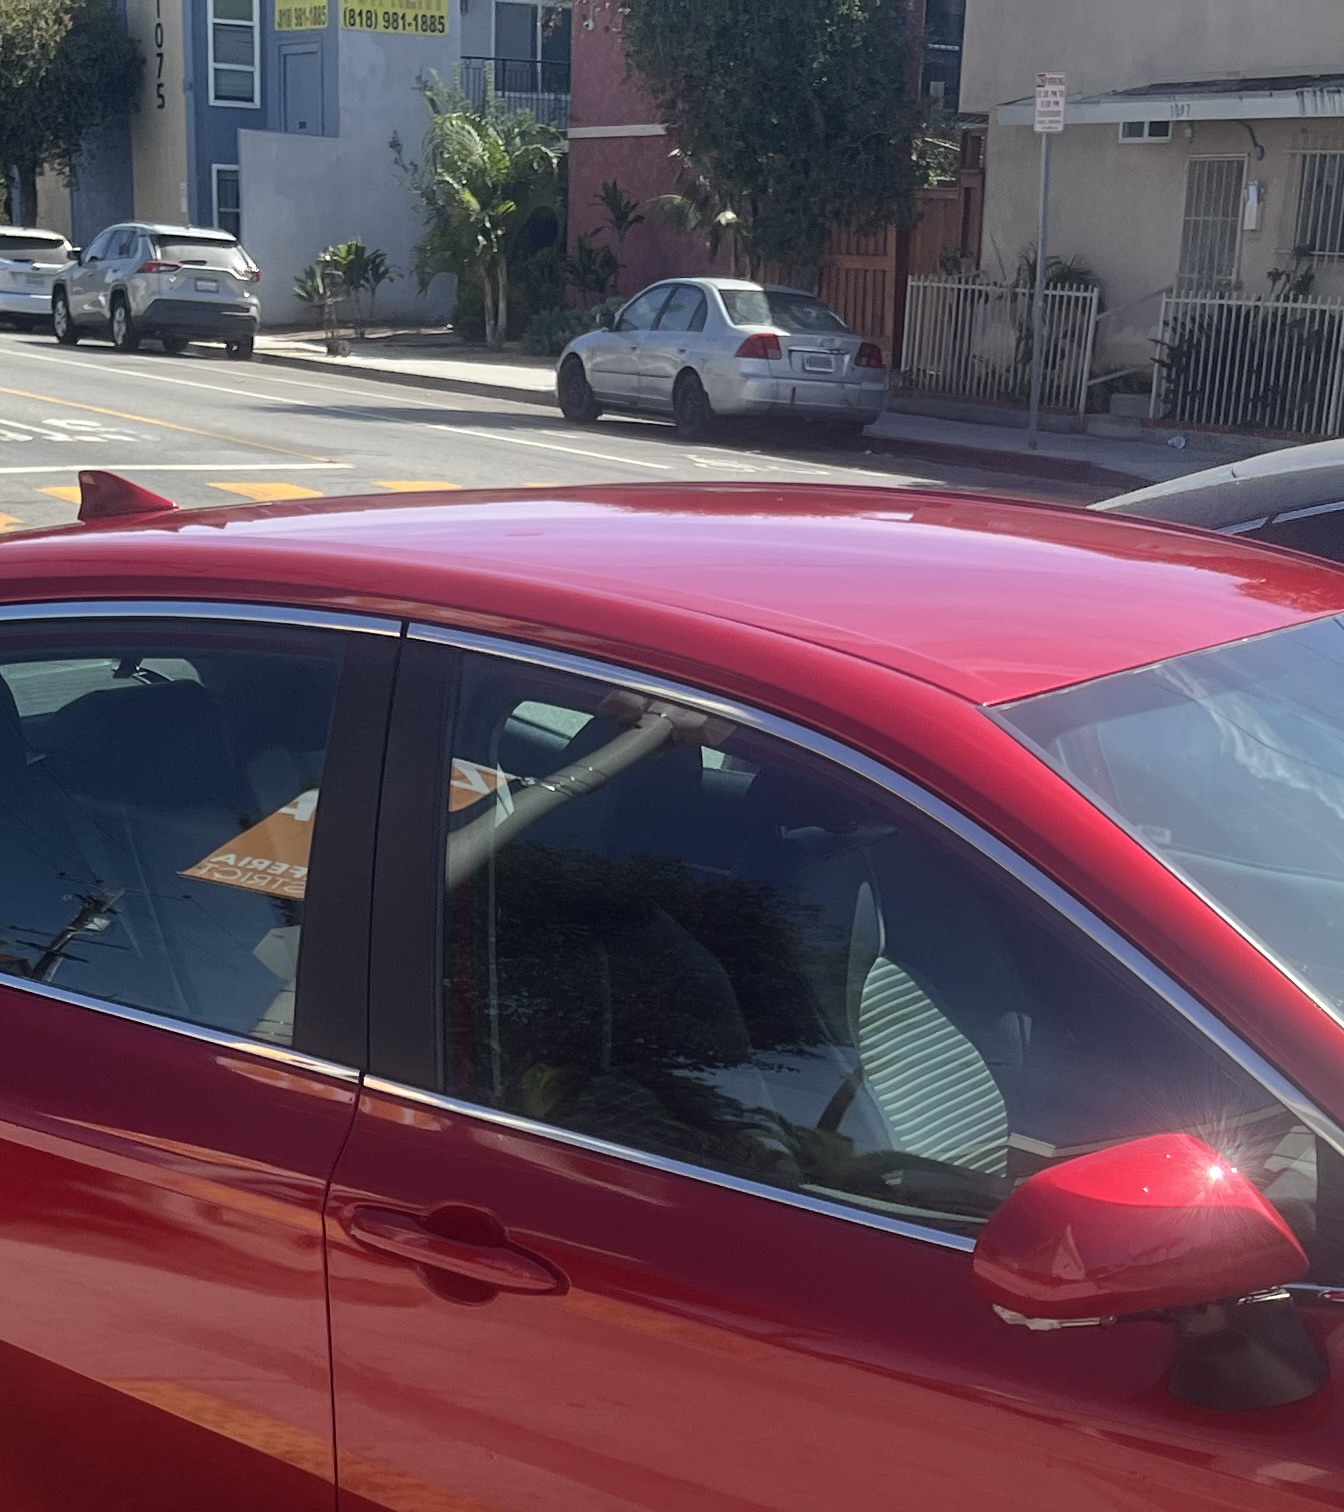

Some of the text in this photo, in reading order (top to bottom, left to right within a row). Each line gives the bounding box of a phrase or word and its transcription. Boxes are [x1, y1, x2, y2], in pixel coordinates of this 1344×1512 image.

[154, 0, 166, 109] 1075
[343, 7, 446, 34] (818) 981-1885
